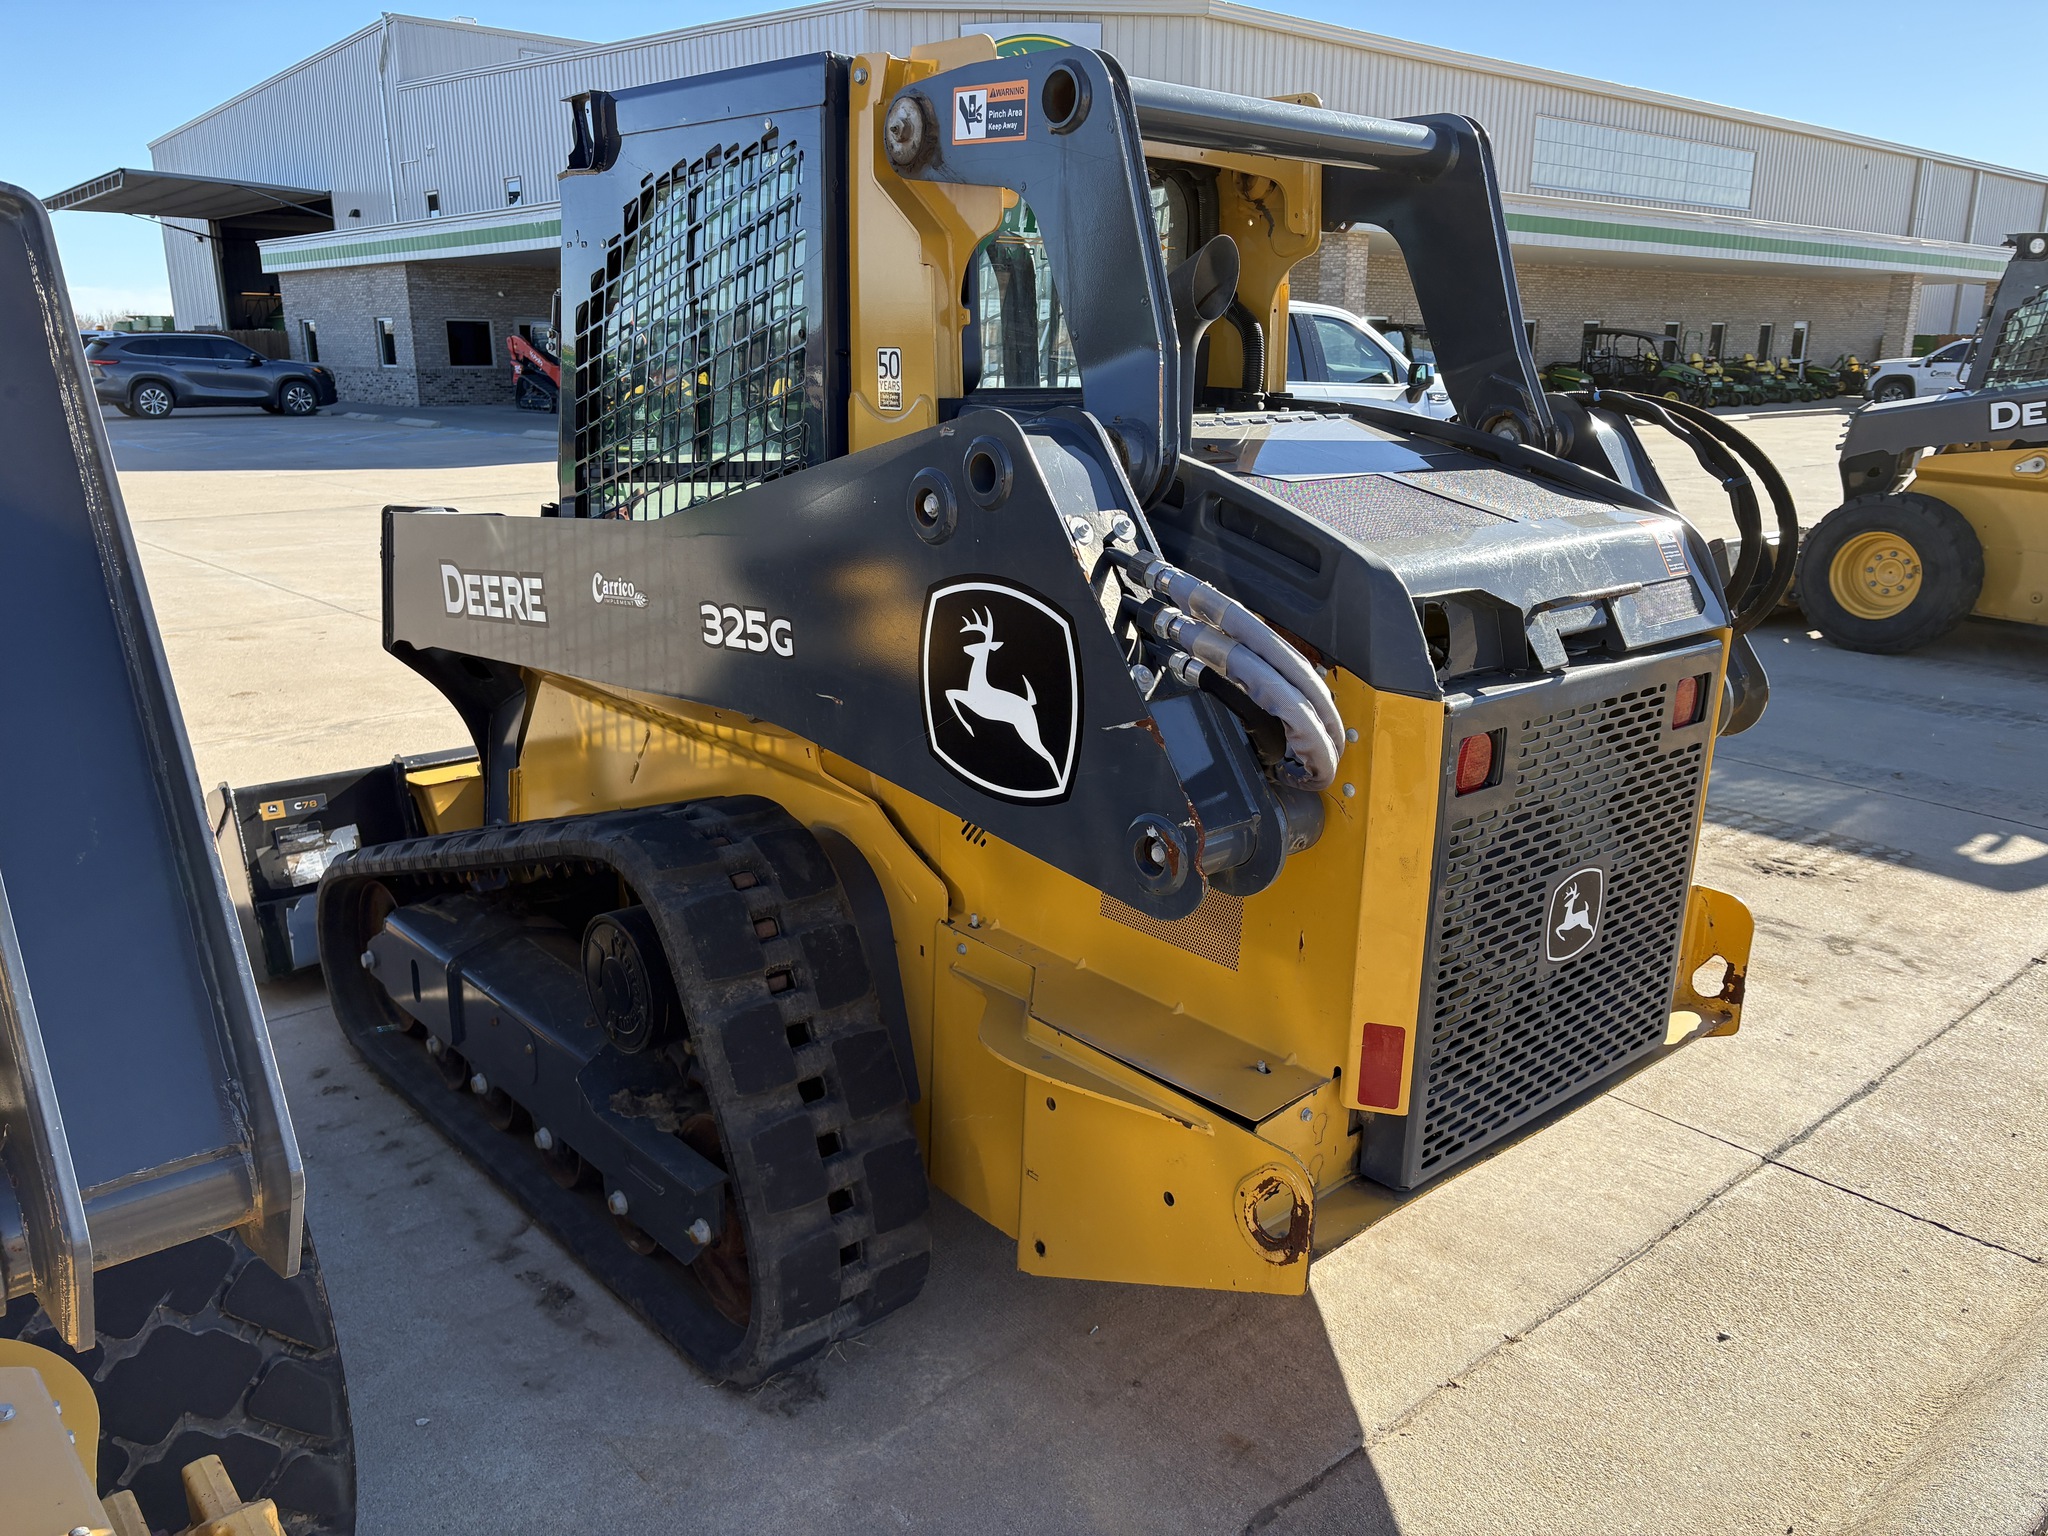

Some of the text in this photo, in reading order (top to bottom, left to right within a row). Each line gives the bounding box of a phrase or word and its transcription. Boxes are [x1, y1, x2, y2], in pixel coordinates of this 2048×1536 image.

[995, 86, 1025, 97] WARNING
[988, 108, 1023, 119] Pinch Area
[988, 121, 1018, 132] Keep Away
[878, 351, 900, 380] 50
[878, 380, 901, 391] YEARS
[592, 572, 635, 603] Carrico
[440, 564, 547, 623] DEERE
[604, 598, 634, 606] IMPLEMENT
[700, 604, 794, 657] 325G
[294, 799, 318, 811] C78
